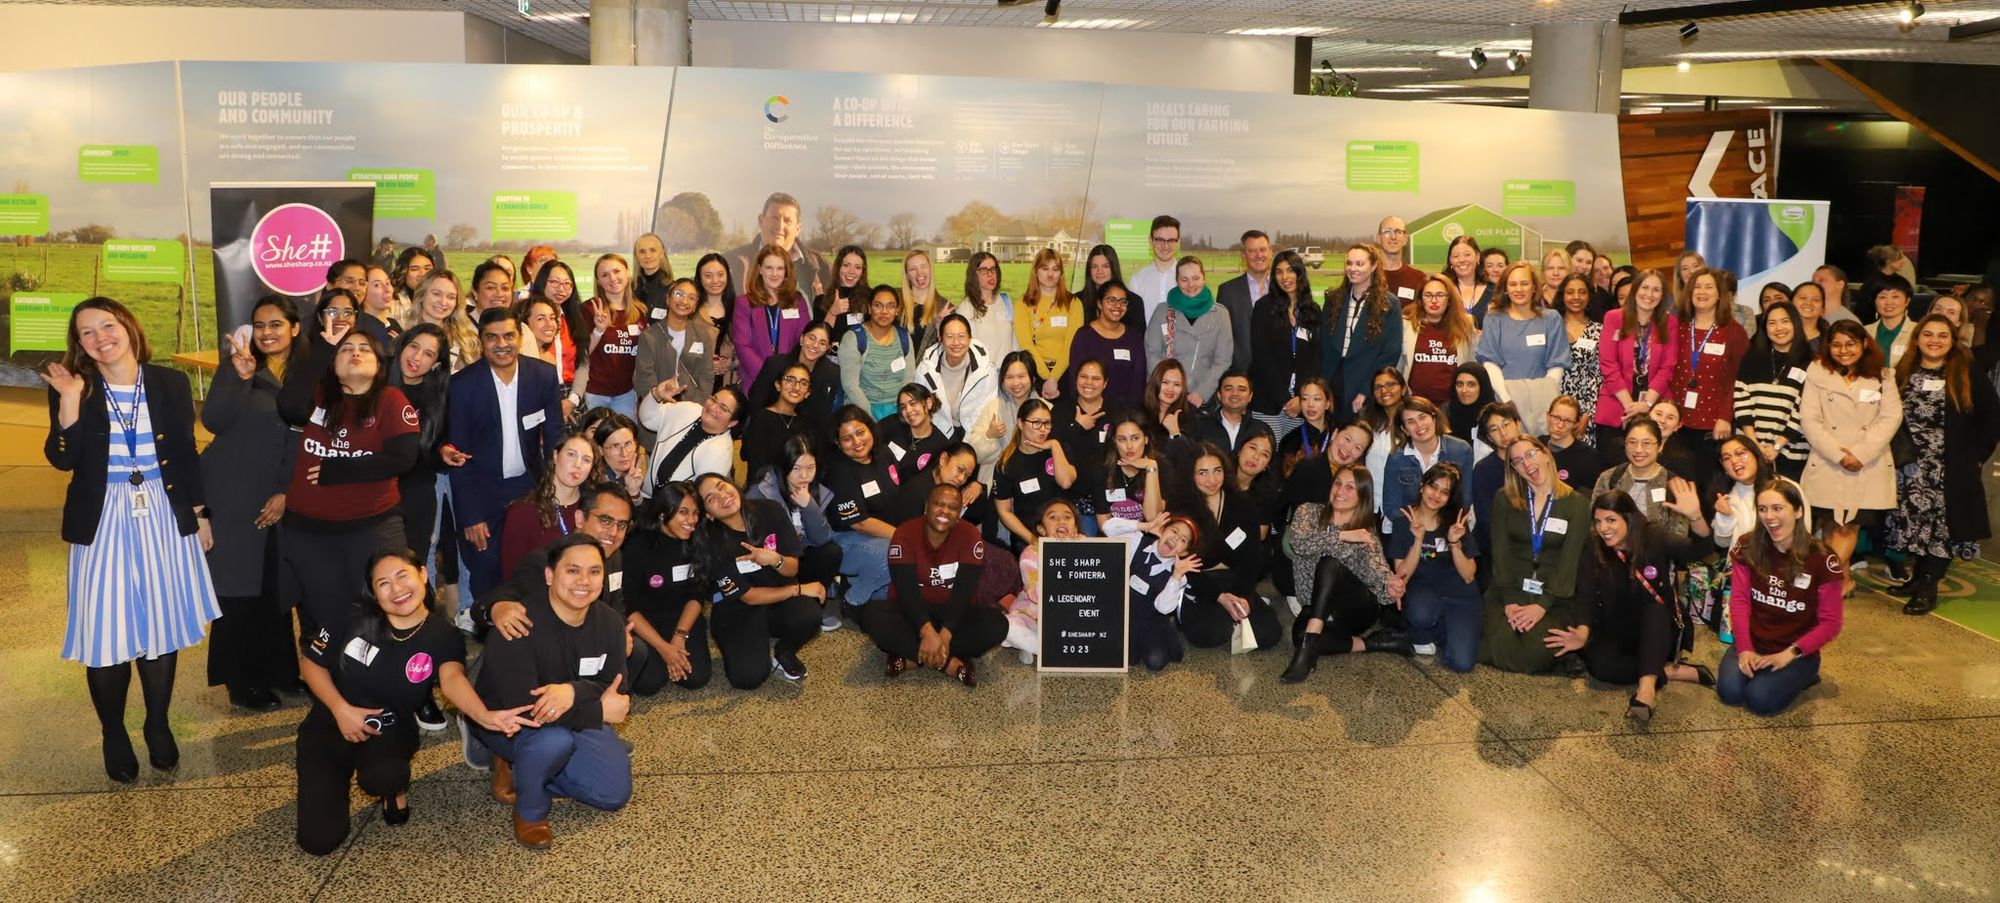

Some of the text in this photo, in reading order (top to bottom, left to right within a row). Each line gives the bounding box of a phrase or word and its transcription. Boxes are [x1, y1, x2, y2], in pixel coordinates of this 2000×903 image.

[219, 91, 302, 107] OUR PEOPLE
[833, 98, 841, 111] A
[845, 98, 878, 112] CO-OP
[502, 104, 528, 119] OUR
[1147, 103, 1231, 117] LOCALS CARING
[219, 109, 334, 124] AND COMMUNITY
[833, 114, 913, 128] A DIFFERENCE
[502, 121, 582, 136] PROSPERITY
[1147, 118, 1249, 134] FOR OUR FARMING
[1147, 132, 1190, 145] FUTURE
[1747, 128, 1768, 199] ACE
[265, 261, 332, 269] www.shesharp.co.nz
[616, 330, 628, 338] Be
[604, 344, 638, 356] Chang
[838, 500, 856, 511] aws
[1057, 571, 1106, 579] & FONTERRA
[1769, 575, 1784, 587] Be
[1769, 587, 1787, 598] the
[1058, 595, 1096, 603] LEGENDARY
[1079, 609, 1100, 617] EVENT
[1063, 645, 1089, 653] 2023
